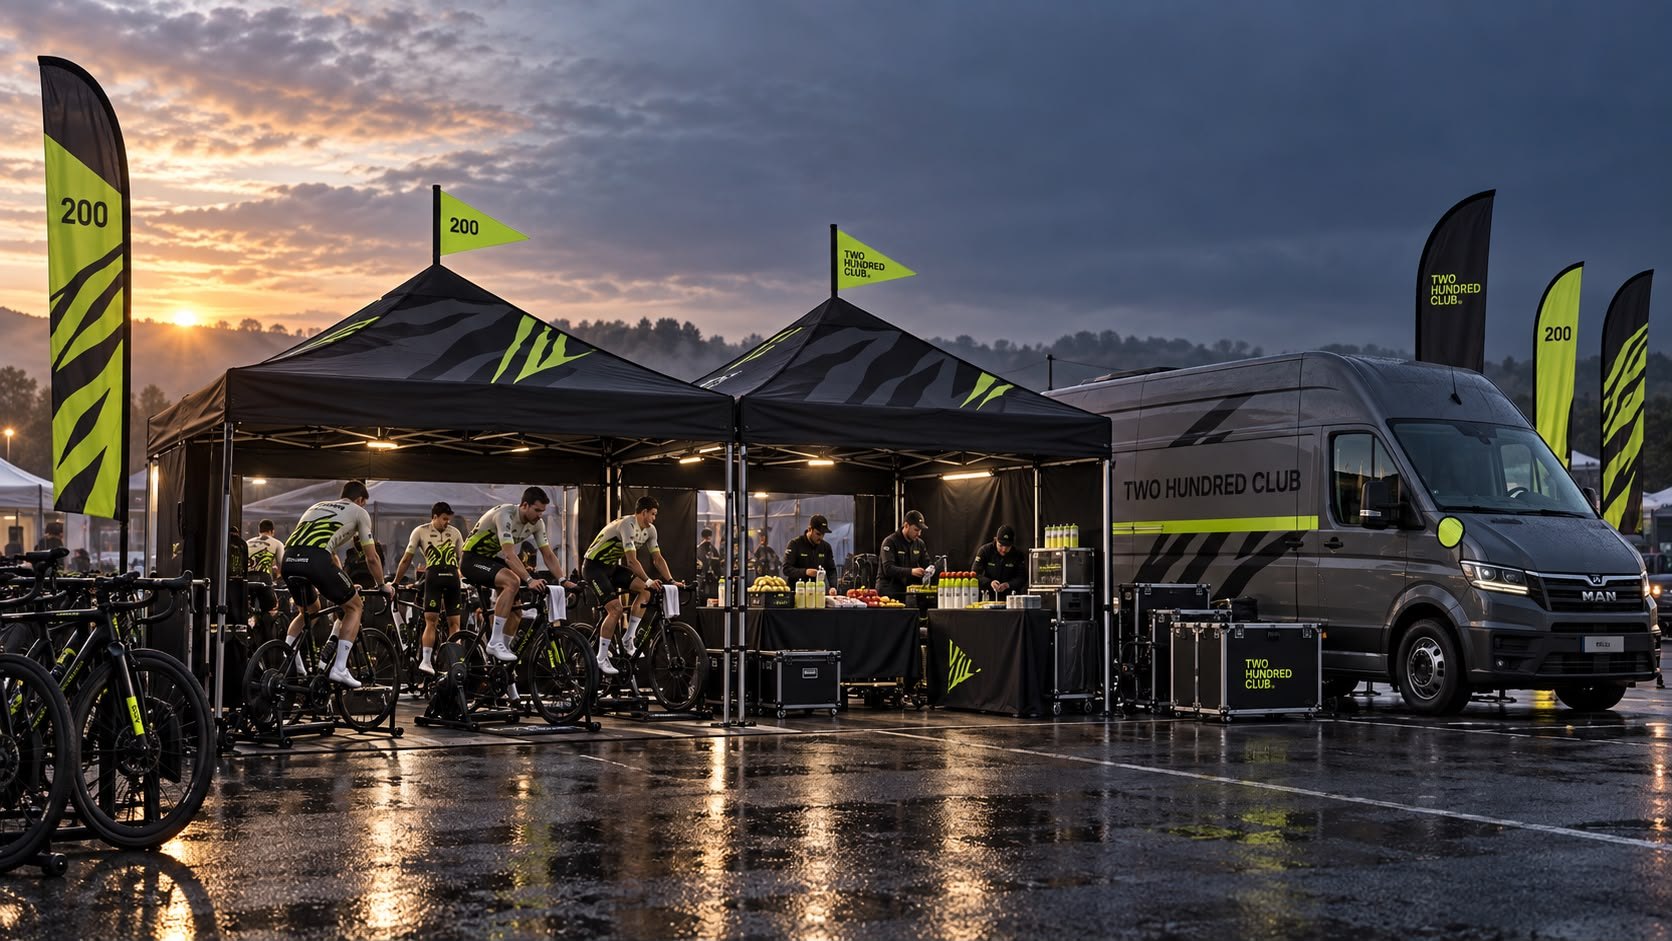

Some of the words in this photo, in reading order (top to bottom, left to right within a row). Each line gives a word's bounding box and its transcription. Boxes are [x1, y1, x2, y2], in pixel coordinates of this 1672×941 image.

[61, 197, 108, 228] 200
[449, 216, 479, 235] 200
[844, 249, 865, 260] TWO
[844, 258, 885, 271] HUNDRED
[1431, 274, 1456, 284] TWO
[1431, 283, 1481, 295] HUNDRED
[1545, 326, 1571, 341] 200
[1124, 479, 1161, 500] TWO
[1166, 473, 1247, 498] HUNDRED
[1252, 470, 1301, 494] CLUB
[1582, 591, 1617, 602] MAN
[1245, 659, 1269, 669] TWO
[1245, 669, 1292, 679] HUNDRED
